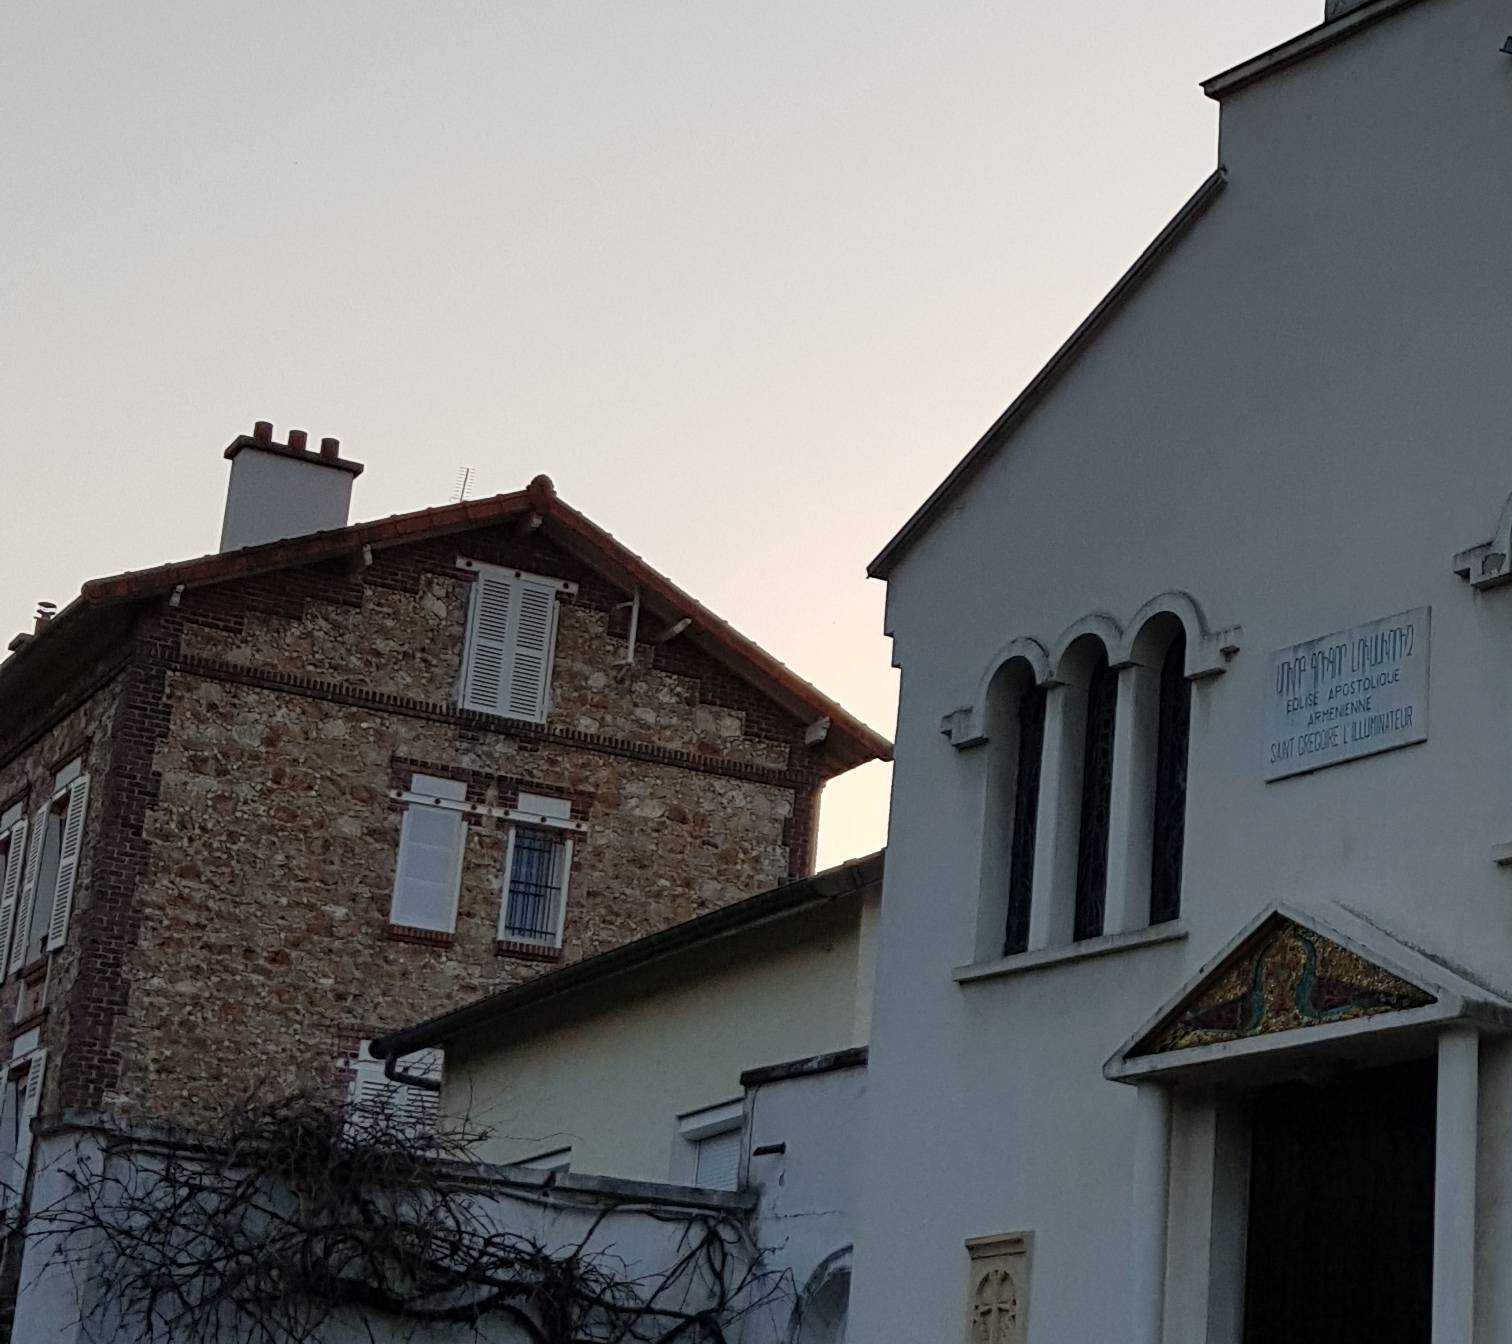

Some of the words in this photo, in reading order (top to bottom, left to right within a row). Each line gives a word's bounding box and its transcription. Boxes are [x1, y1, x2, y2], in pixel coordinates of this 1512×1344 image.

[1286, 694, 1318, 714] EGLISE
[1328, 669, 1401, 700] APOSTOLIQUE
[1307, 697, 1372, 726] ARMENIENNE
[1270, 737, 1294, 763] SAINT
